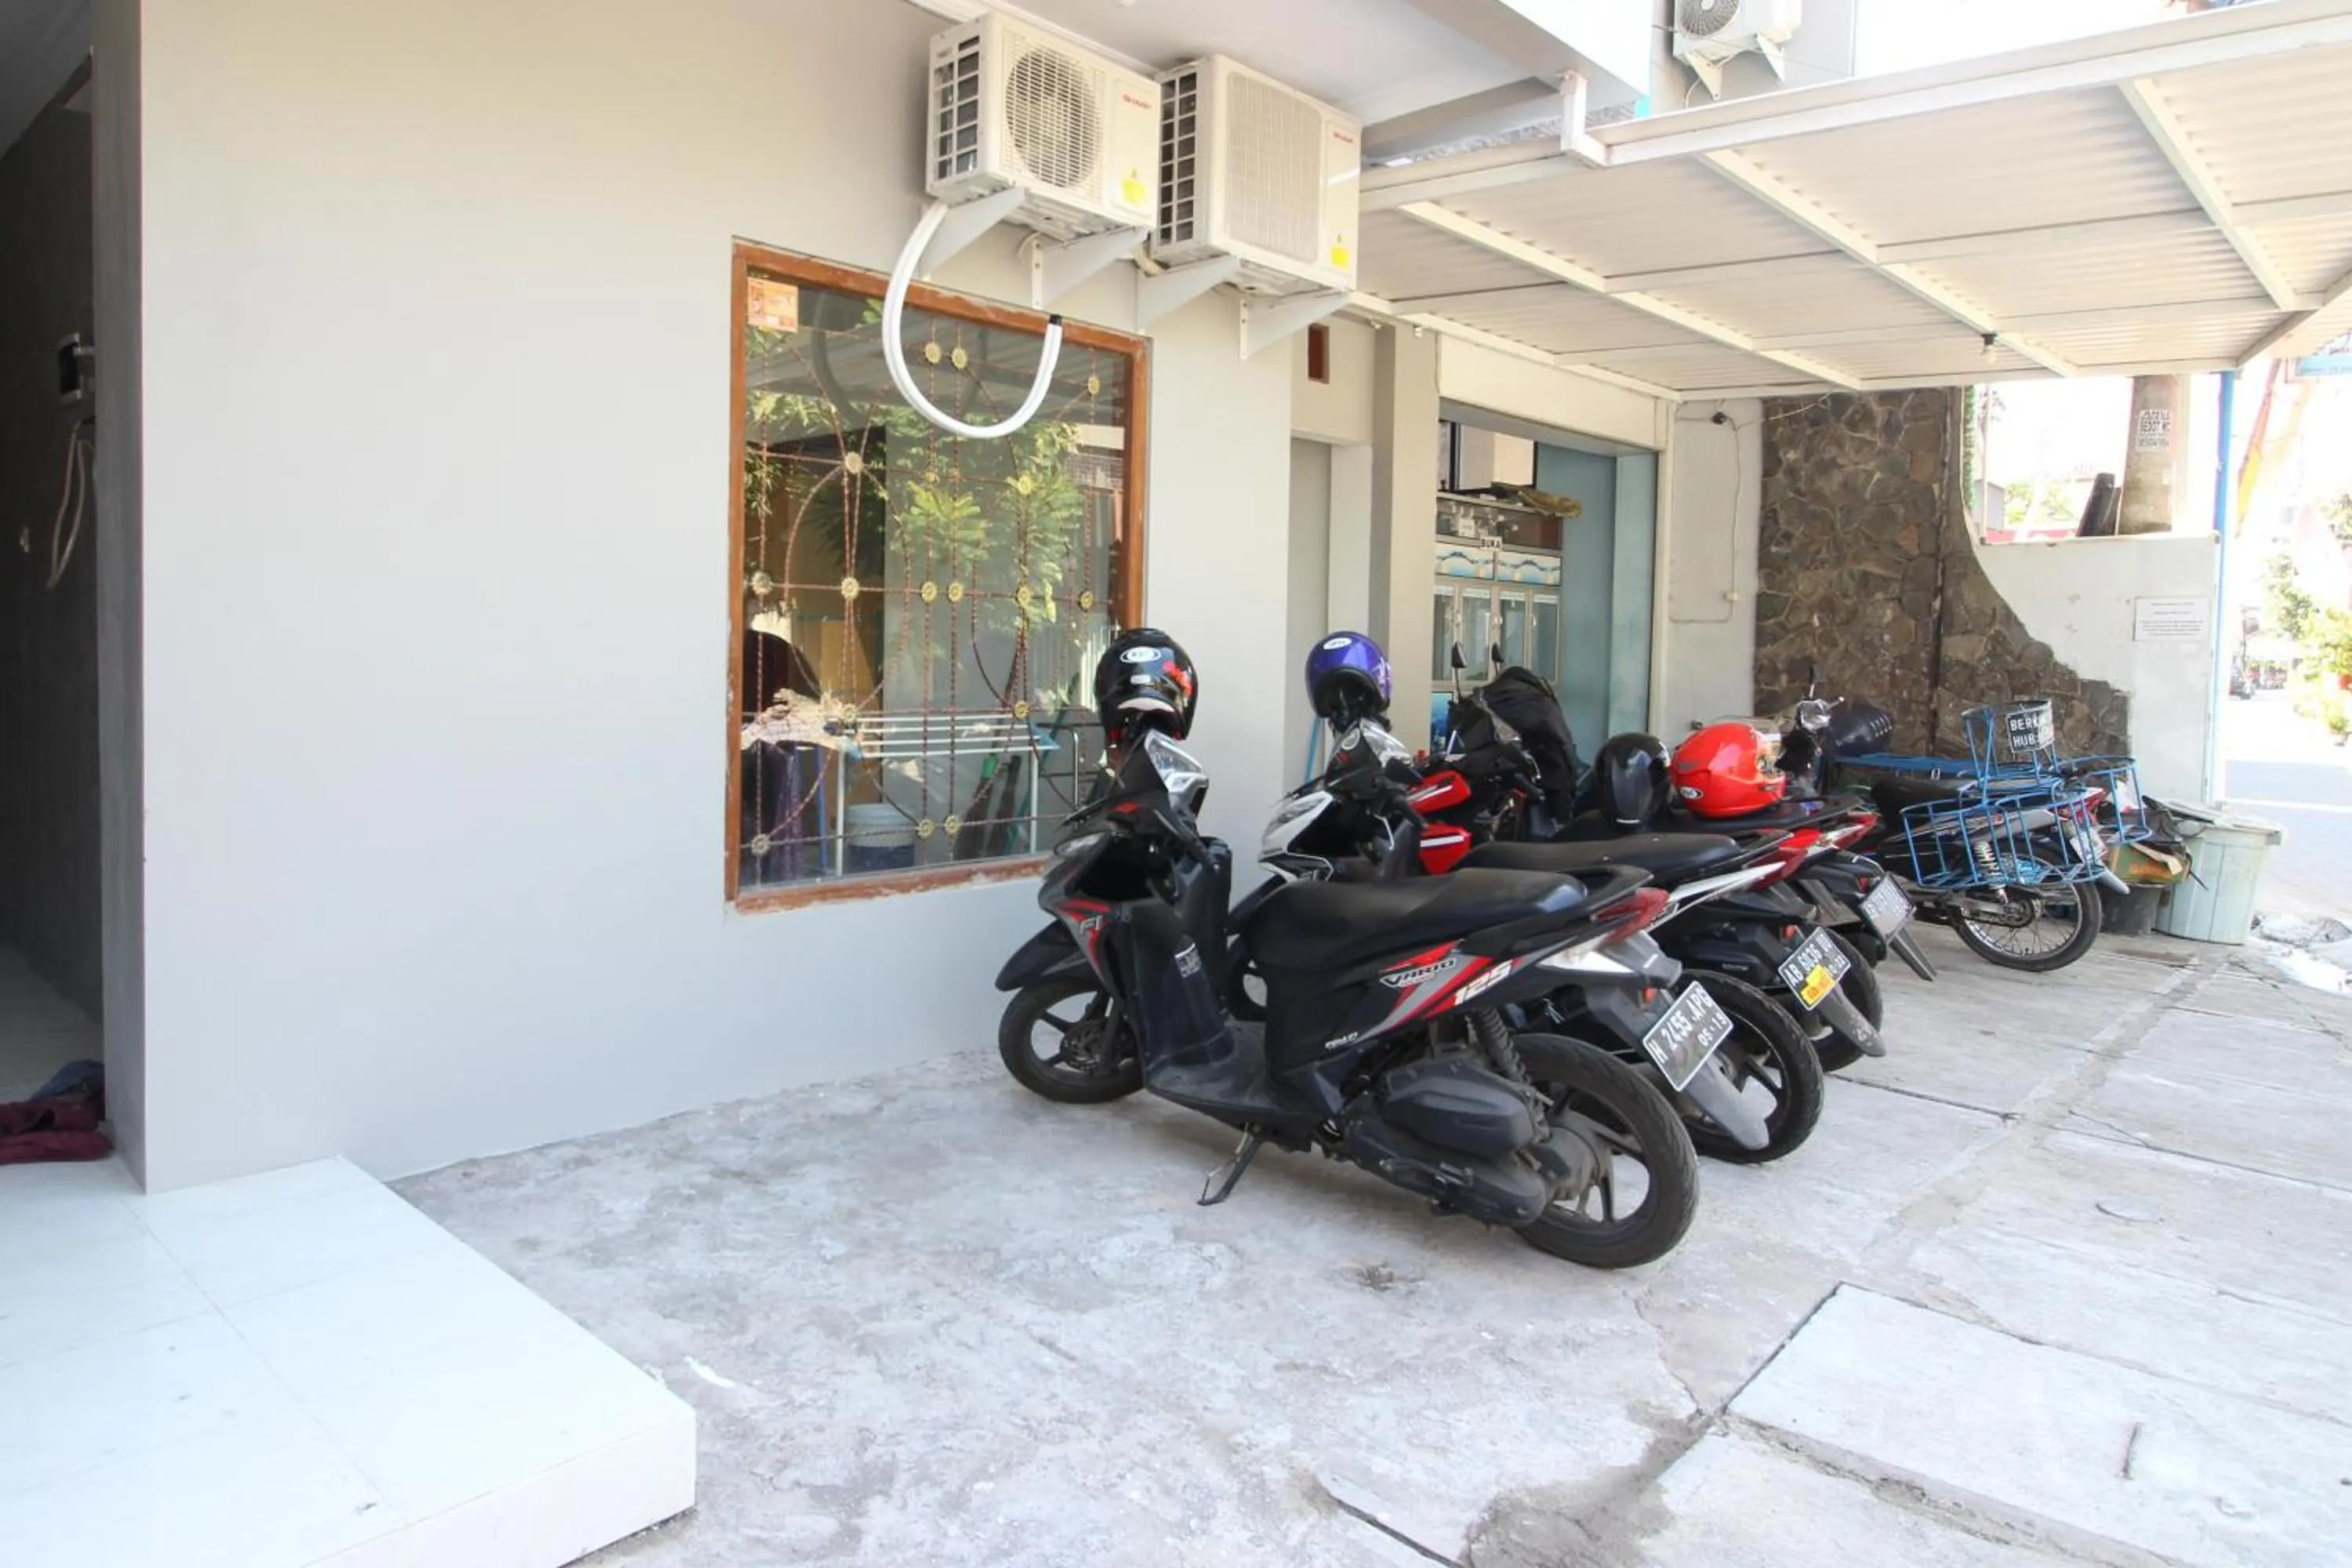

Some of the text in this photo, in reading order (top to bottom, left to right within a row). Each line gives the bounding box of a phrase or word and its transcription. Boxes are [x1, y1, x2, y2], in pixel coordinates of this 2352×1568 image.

[1454, 959, 1513, 1006] 125
[1784, 963, 1804, 987] AB
[1661, 1009, 1693, 1051] 2455
